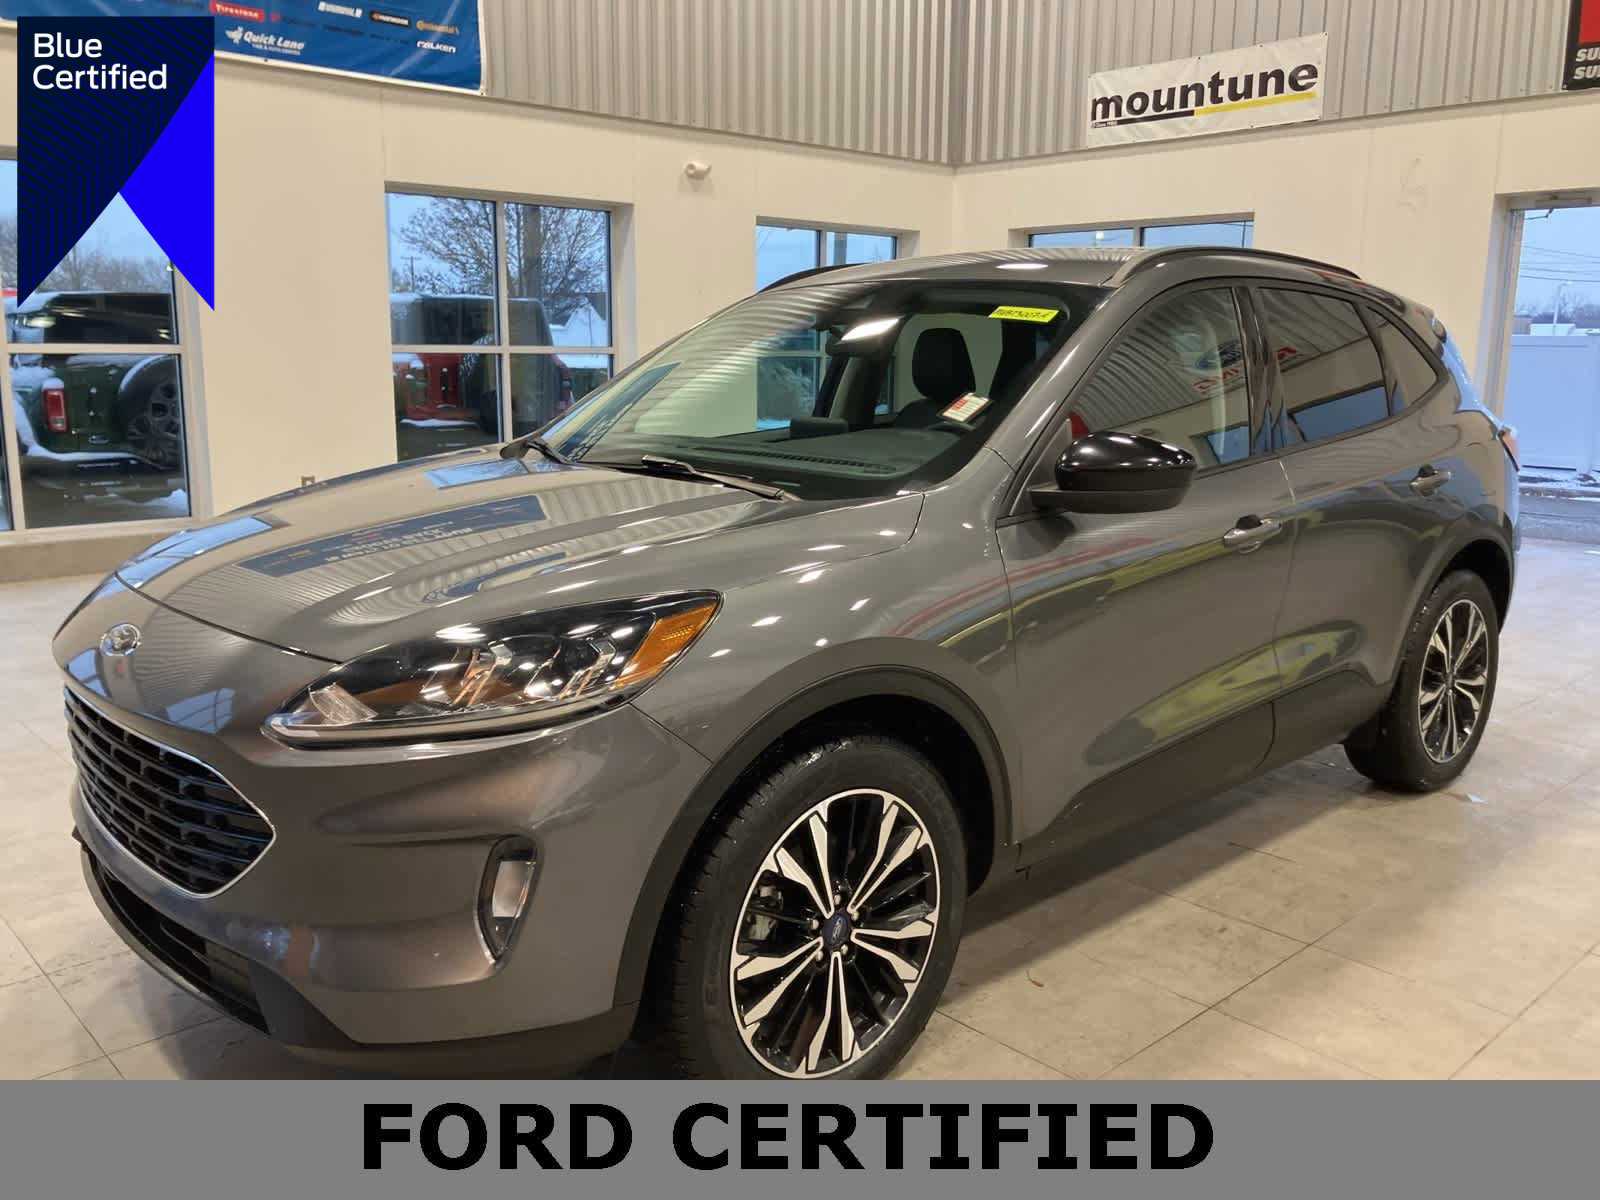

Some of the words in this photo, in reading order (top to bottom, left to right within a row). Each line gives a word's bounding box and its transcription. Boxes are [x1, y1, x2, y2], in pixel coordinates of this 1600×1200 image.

[243, 31, 276, 45] Quick
[276, 36, 305, 50] Lane
[1575, 47, 1600, 62] SU
[1091, 63, 1318, 121] mountune
